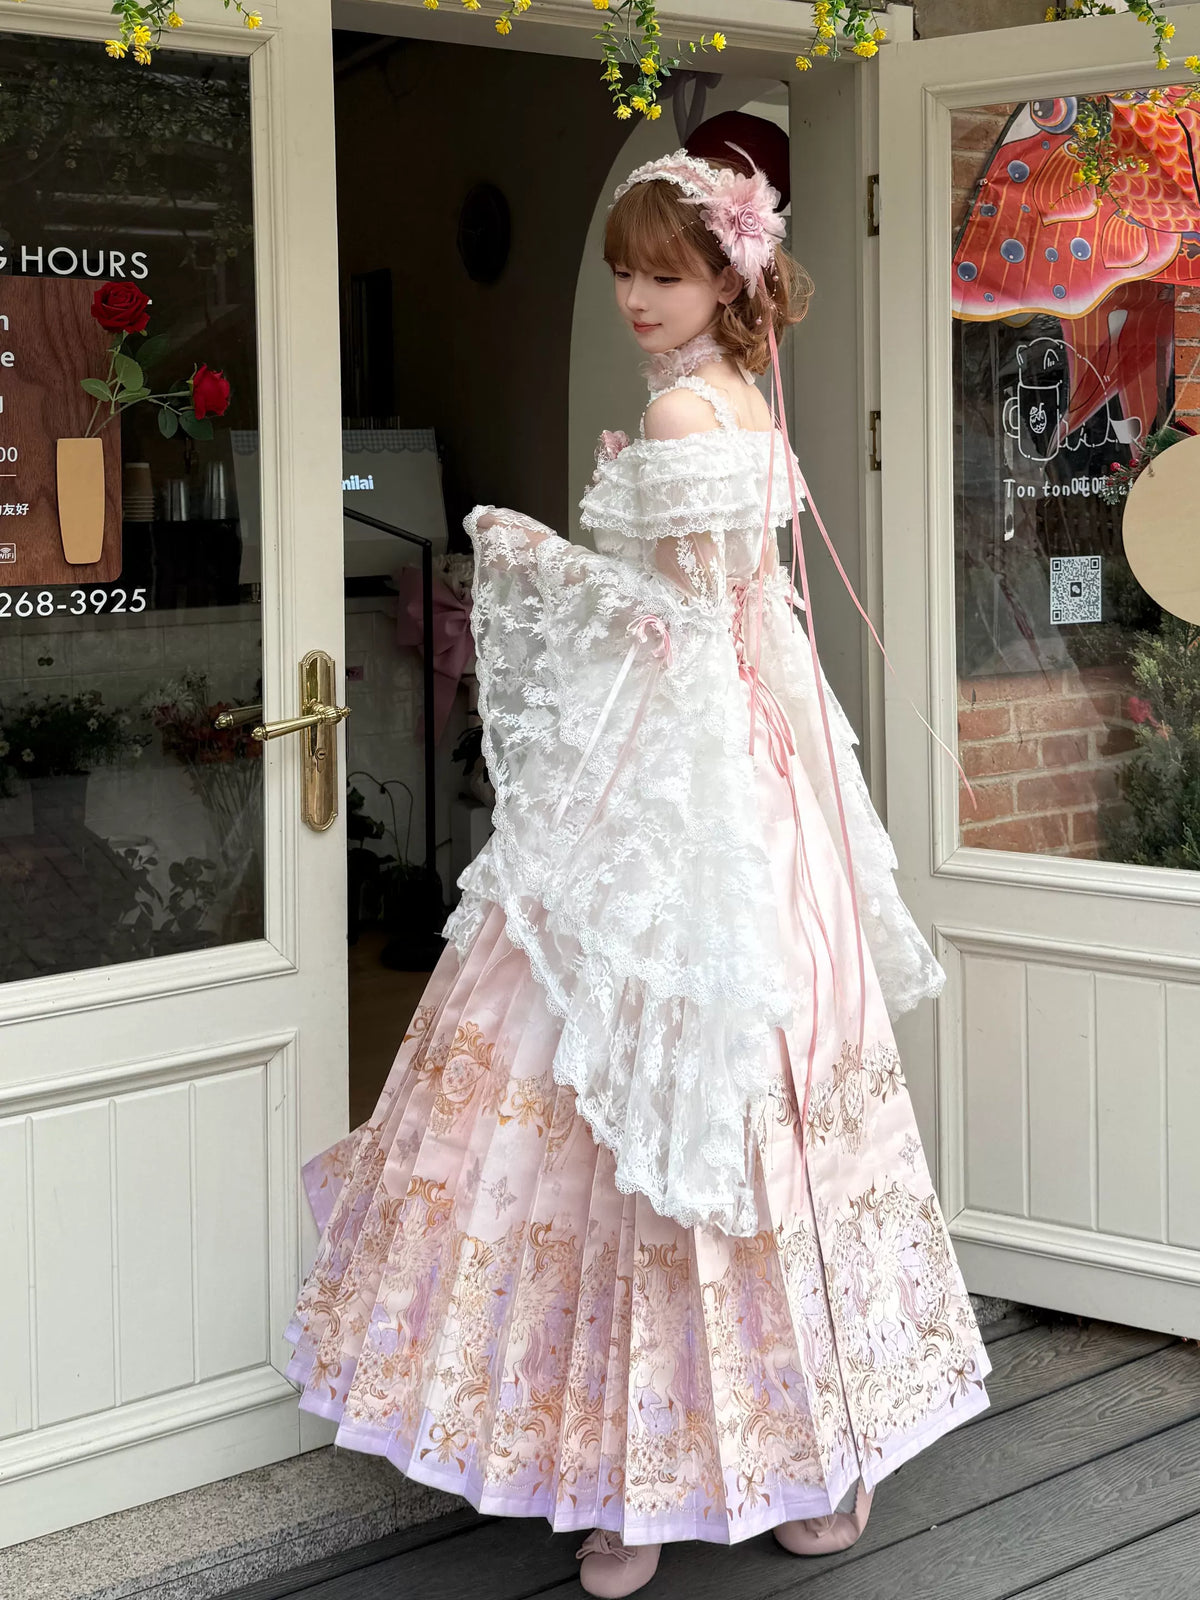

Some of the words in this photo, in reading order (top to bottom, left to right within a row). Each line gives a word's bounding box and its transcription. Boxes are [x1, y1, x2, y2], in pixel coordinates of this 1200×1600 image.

[21, 245, 149, 279] HOURS
[1003, 478, 1036, 498] Ton
[0, 503, 30, 516] 友好
[0, 588, 147, 618] 268-3925
